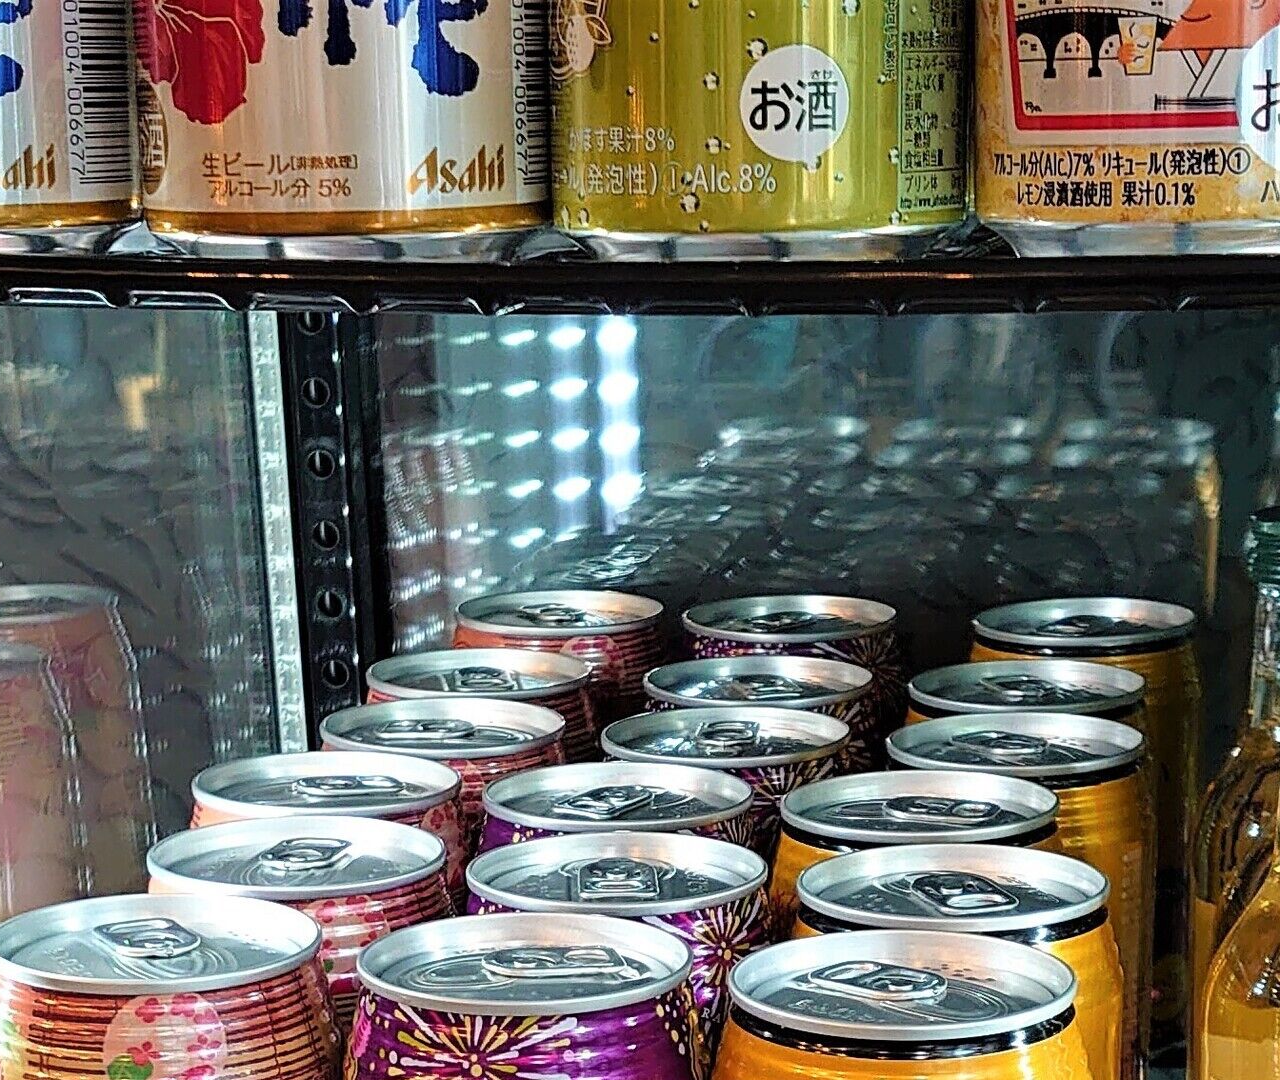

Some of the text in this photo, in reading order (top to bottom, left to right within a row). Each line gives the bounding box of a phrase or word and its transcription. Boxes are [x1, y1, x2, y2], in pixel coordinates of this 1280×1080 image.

[67, 87, 85, 176] 006677
[749, 79, 838, 132] お酒
[208, 178, 352, 199] アルコール分 5%
[407, 143, 506, 195] Asahi
